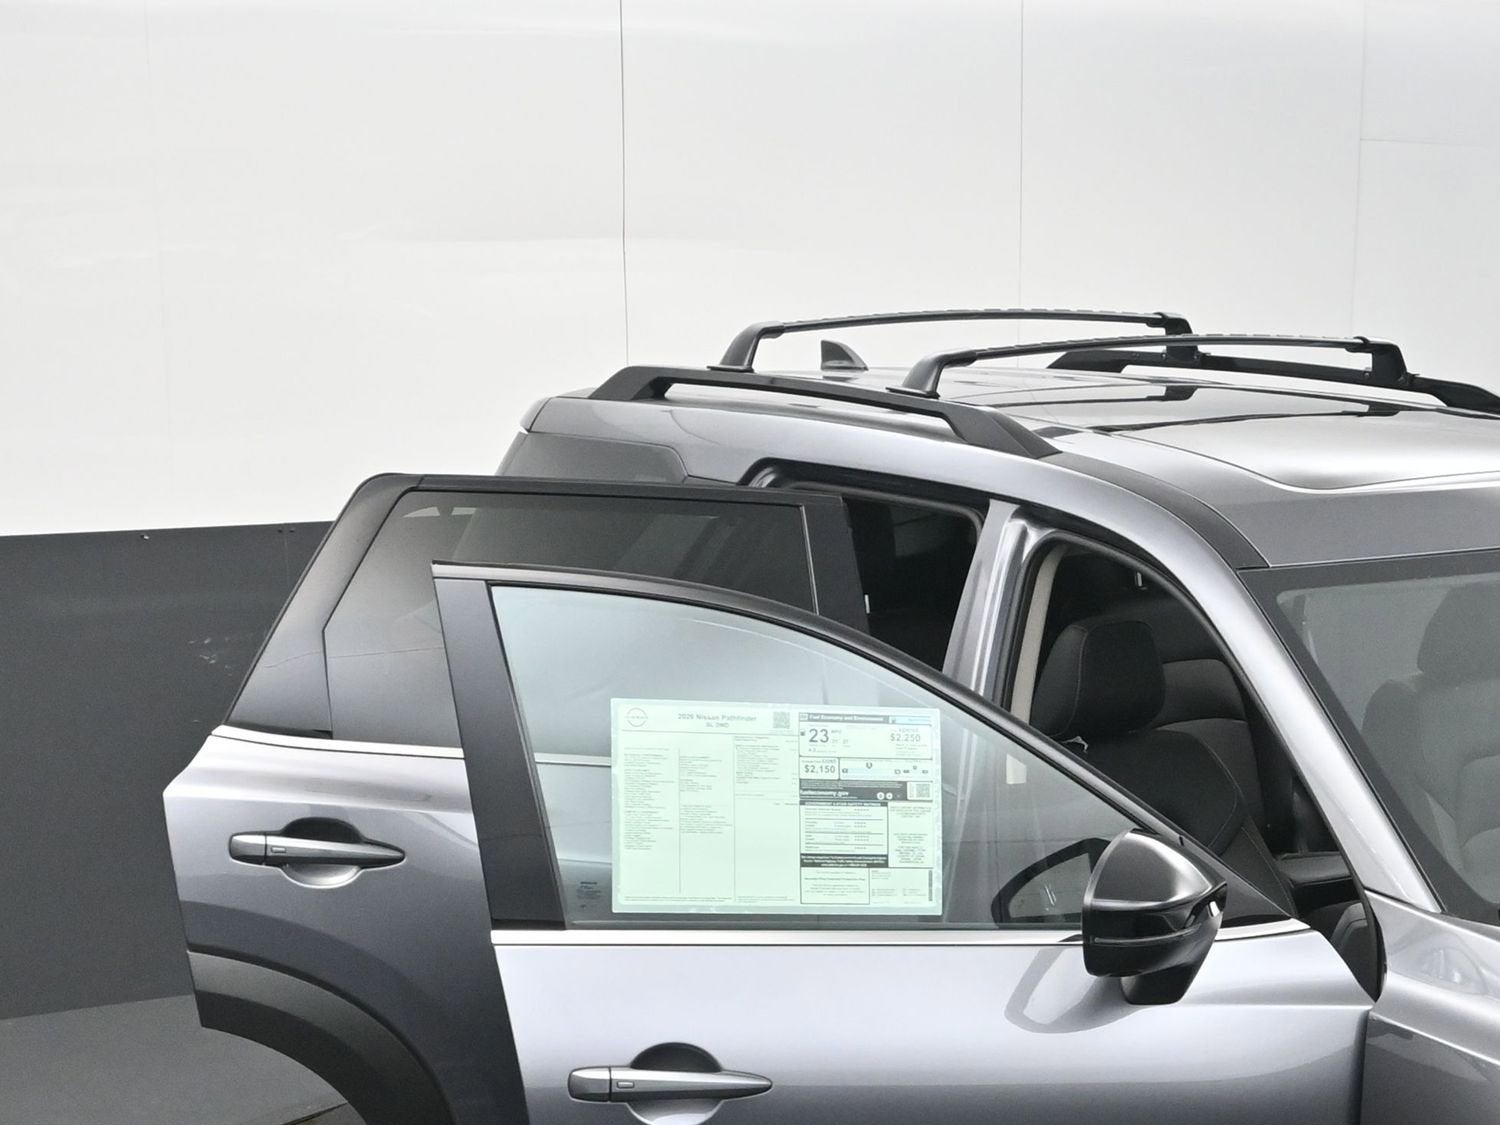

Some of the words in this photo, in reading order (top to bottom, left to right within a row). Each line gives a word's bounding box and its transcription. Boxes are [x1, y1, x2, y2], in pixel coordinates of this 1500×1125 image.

[696, 713, 719, 721] Nissan
[809, 728, 829, 743] 23
[804, 764, 836, 774] $2,150
